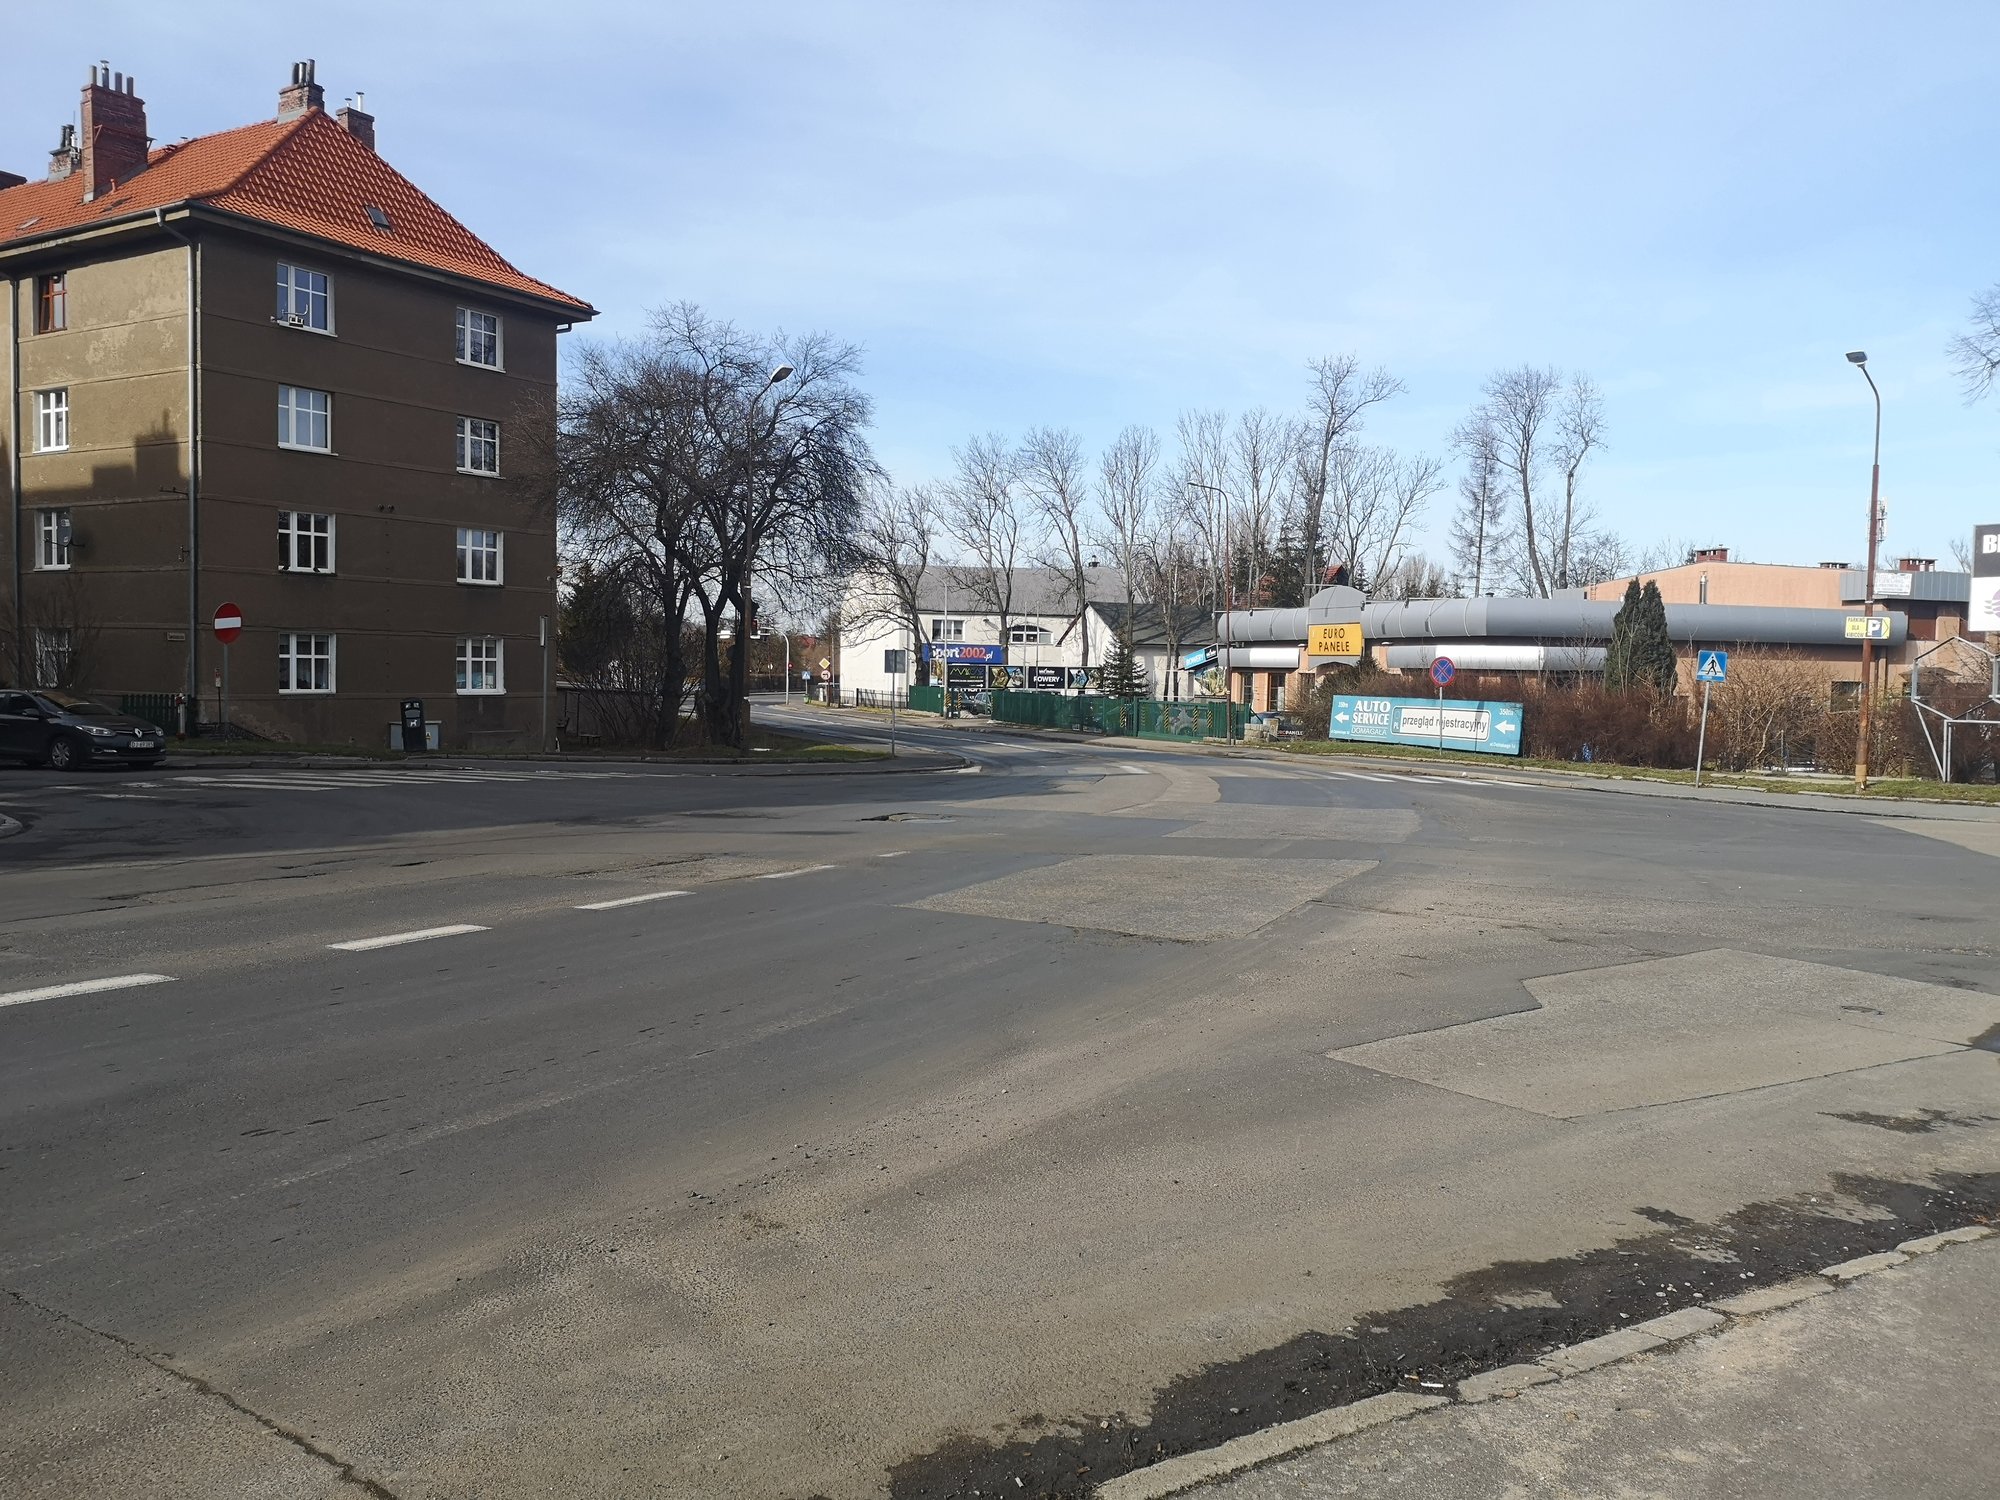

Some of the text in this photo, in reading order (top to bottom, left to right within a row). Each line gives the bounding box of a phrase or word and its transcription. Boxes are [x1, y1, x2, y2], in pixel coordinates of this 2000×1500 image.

[1982, 534, 2000, 554] B
[1323, 627, 1346, 639] EURO
[1318, 641, 1350, 652] PANELE
[1353, 700, 1391, 713] AUTO
[1352, 712, 1390, 726] SERVICE
[1401, 715, 1434, 730] przegląd
